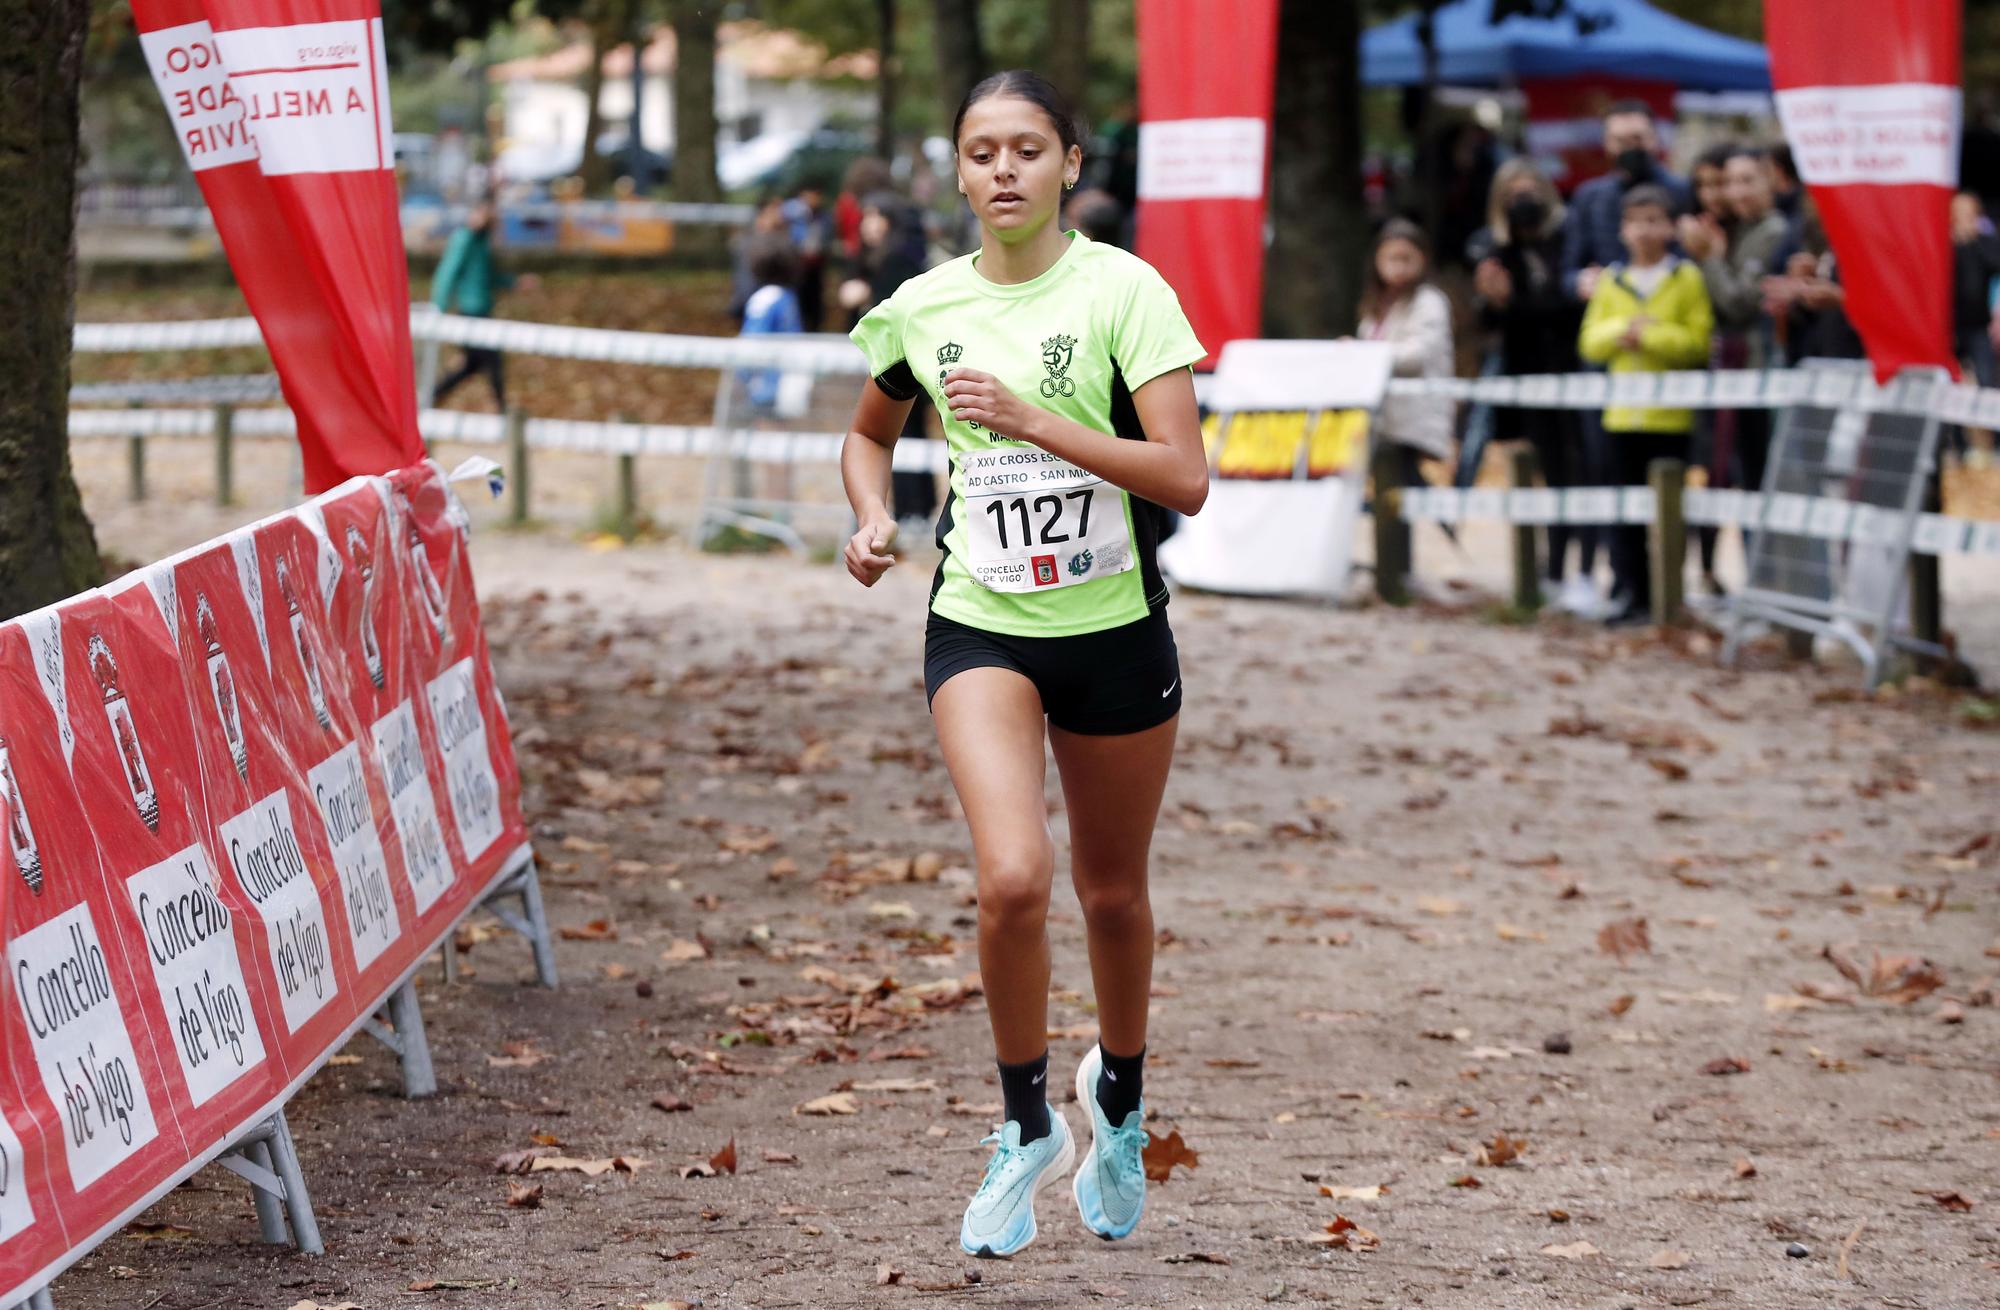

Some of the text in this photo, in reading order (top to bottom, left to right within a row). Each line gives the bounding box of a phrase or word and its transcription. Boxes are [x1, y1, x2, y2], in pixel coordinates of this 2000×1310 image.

[968, 476, 982, 487] AD
[983, 472, 1028, 487] CASTRO
[1040, 469, 1065, 481] SAN
[977, 456, 996, 468] XXV
[999, 453, 1038, 466] CROSS
[986, 489, 1095, 549] 1127
[977, 564, 1025, 574] CONCELLO
[999, 574, 1022, 583] VIGO
[316, 756, 372, 847] Concello
[231, 808, 303, 904] Concello
[346, 853, 388, 939] de Vigo
[139, 861, 228, 966] Concello
[276, 906, 325, 999] de Vigo
[18, 922, 110, 1040] Concello
[175, 969, 245, 1068] de Vigo
[57, 1042, 134, 1148] de Vigo
